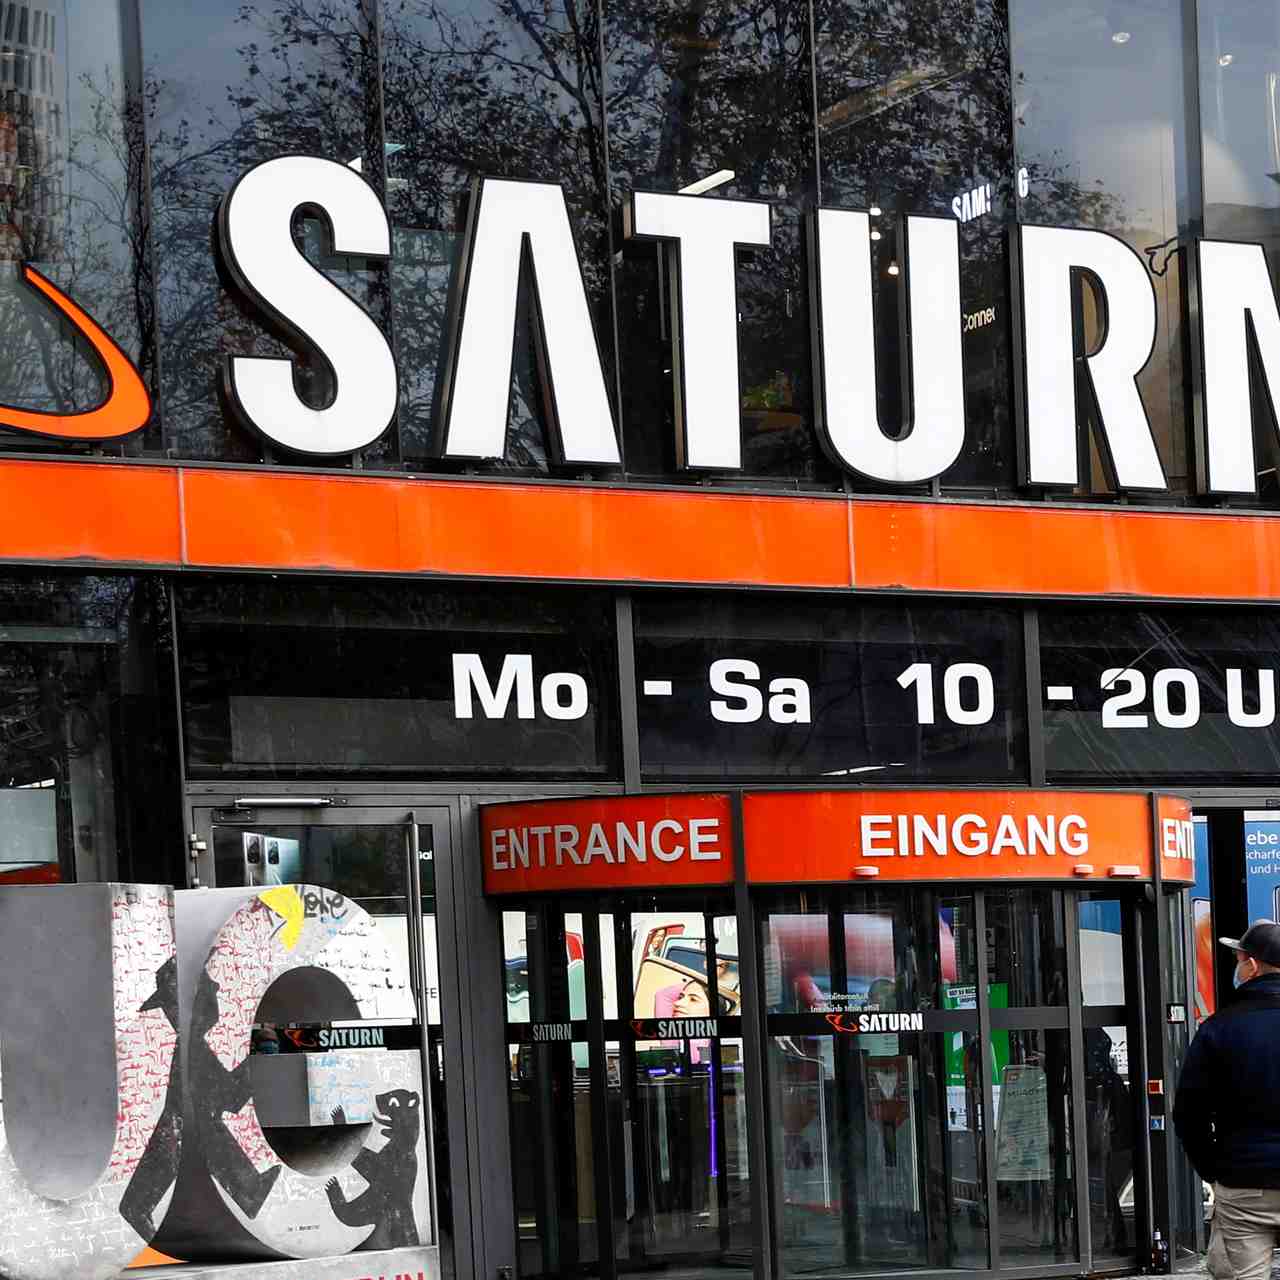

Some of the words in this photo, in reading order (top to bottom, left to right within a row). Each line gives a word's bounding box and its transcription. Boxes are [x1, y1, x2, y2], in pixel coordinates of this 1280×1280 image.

[452, 653, 588, 720] Mo
[709, 659, 811, 724] Sa
[896, 663, 994, 725] 10
[1100, 668, 1200, 729] 20
[490, 818, 722, 871] ENTRANCE
[861, 814, 1089, 857] EINGANG
[532, 1023, 573, 1041] SATURN
[658, 1019, 718, 1039] SATURN
[858, 1013, 924, 1032] SATURN
[318, 1028, 384, 1047] SATURN
